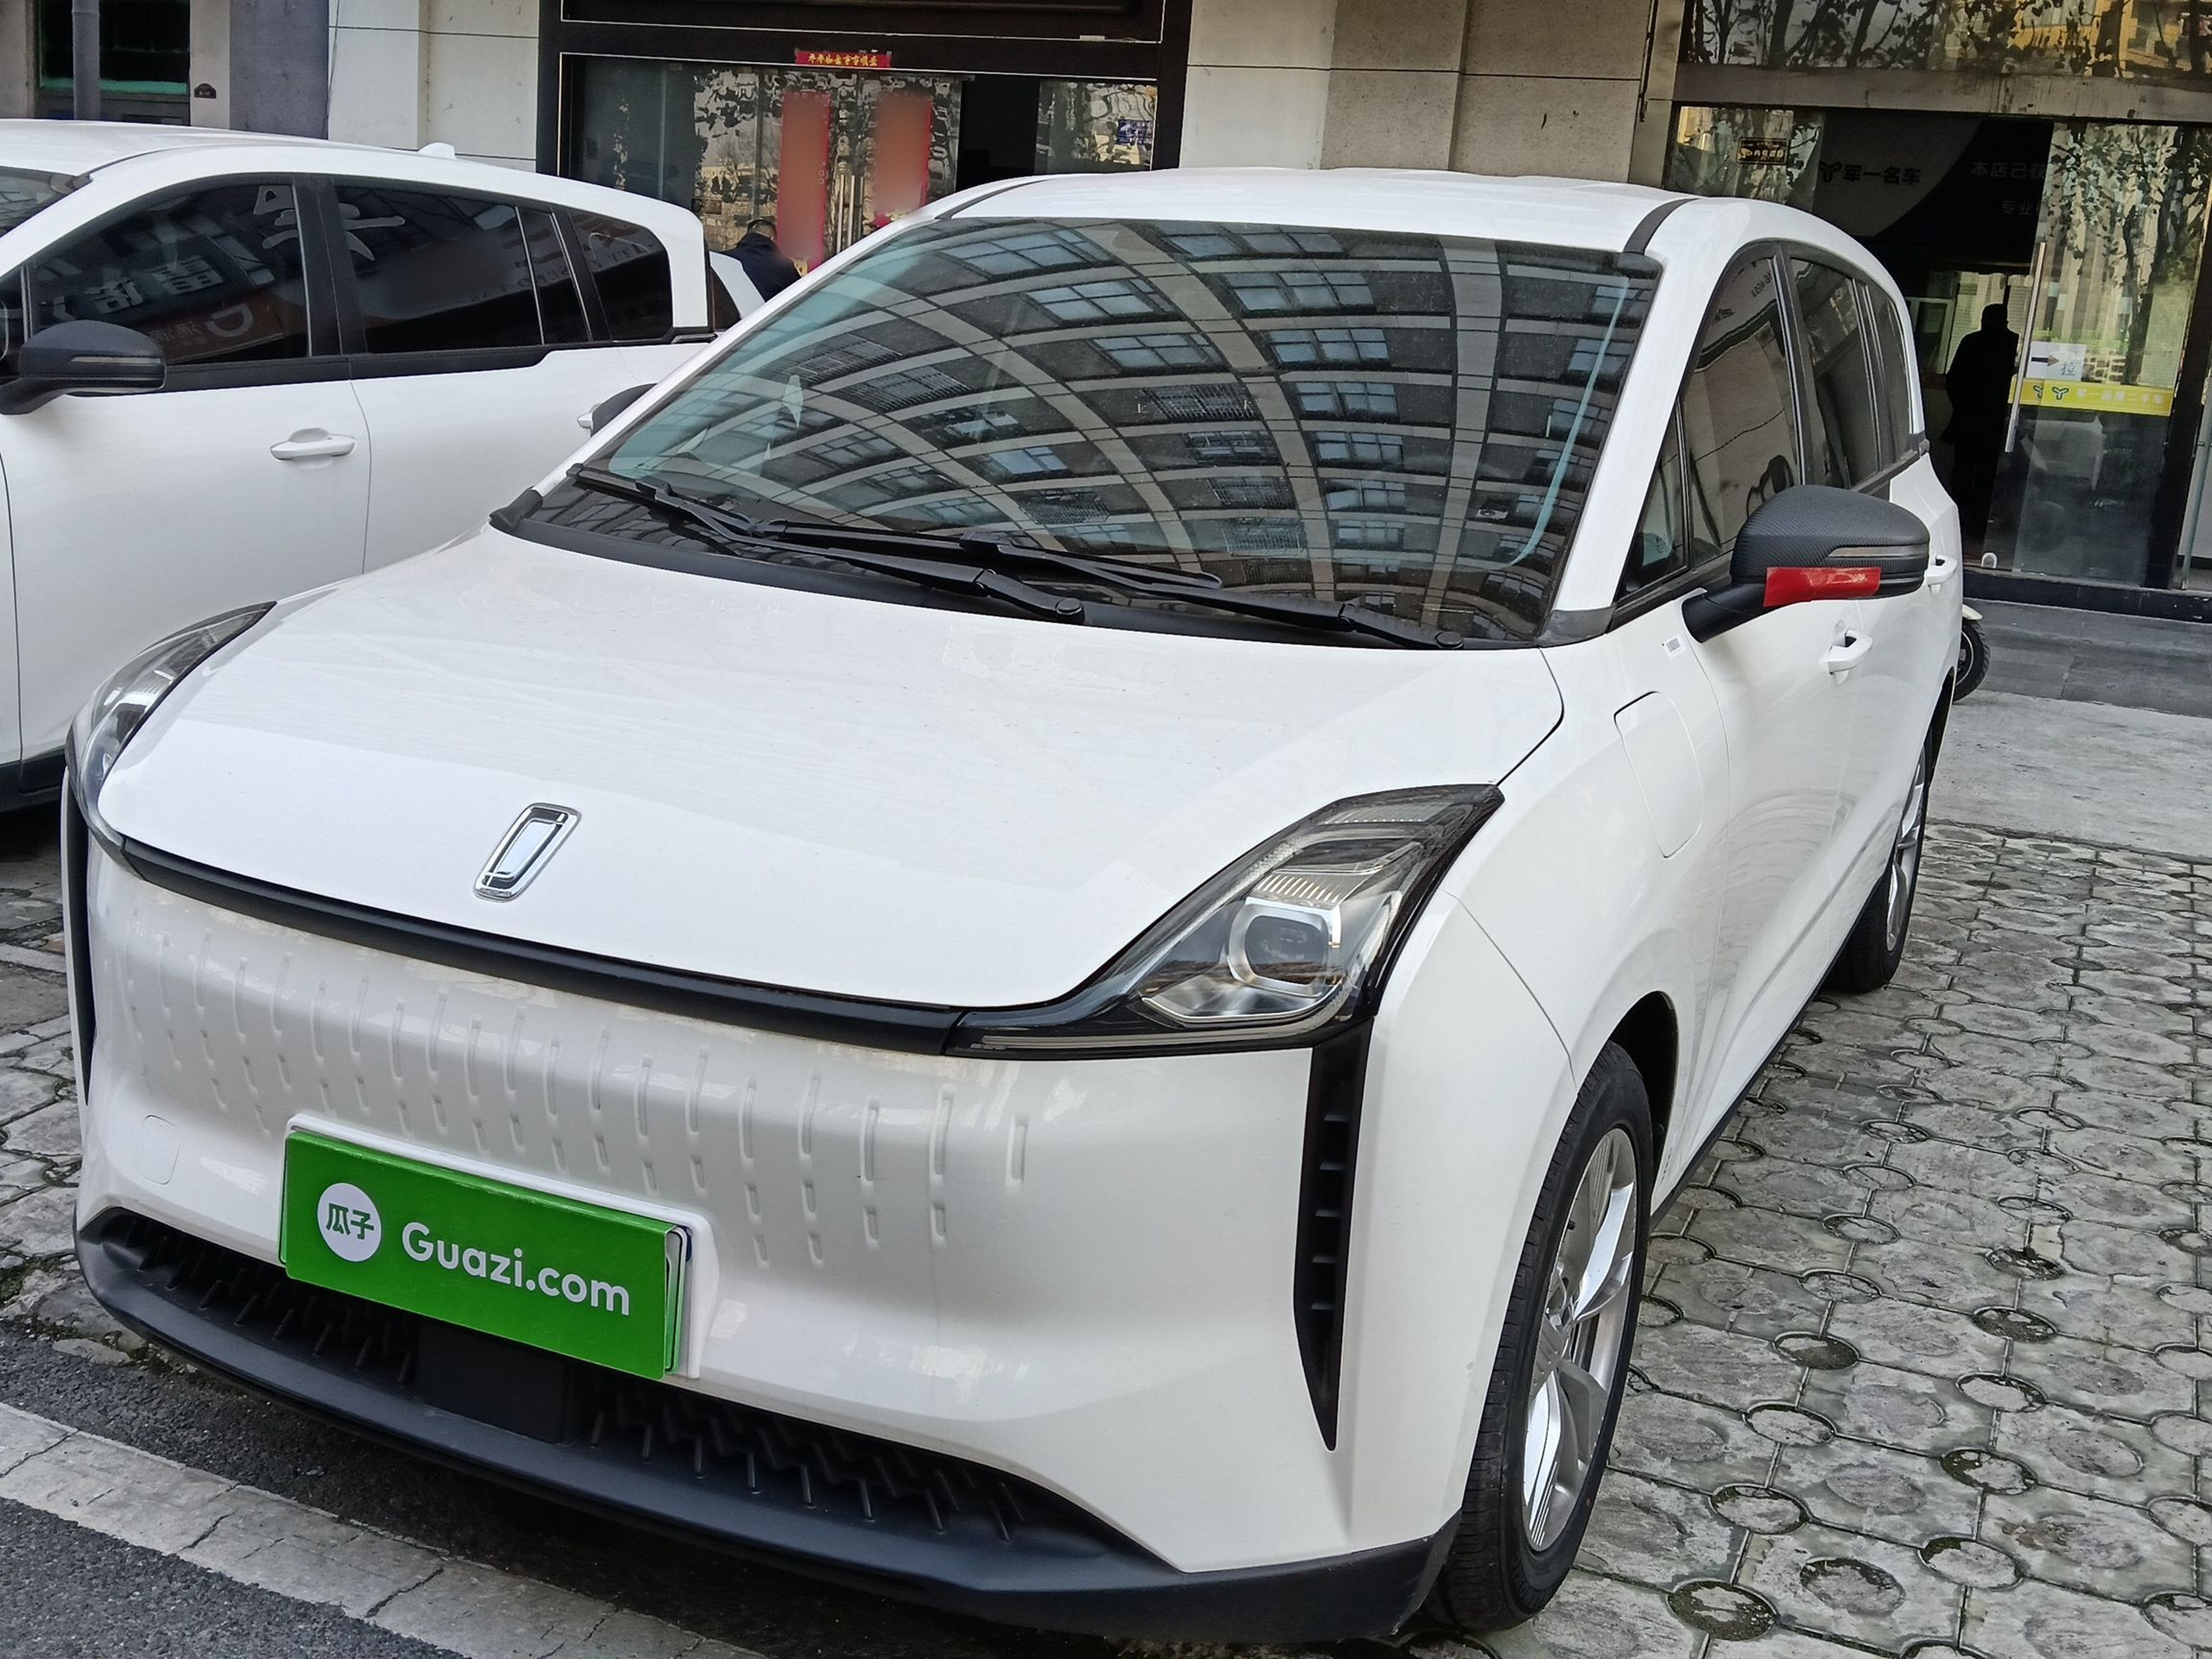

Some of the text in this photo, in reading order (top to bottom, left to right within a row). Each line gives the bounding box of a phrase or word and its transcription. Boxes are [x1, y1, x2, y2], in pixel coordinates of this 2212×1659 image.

[1843, 164, 1921, 185] 军一名车
[2000, 199, 2039, 217] 专业
[2060, 361, 2076, 376] 拉
[325, 1202, 375, 1240] 瓜子
[402, 1221, 630, 1316] Guazi.com
